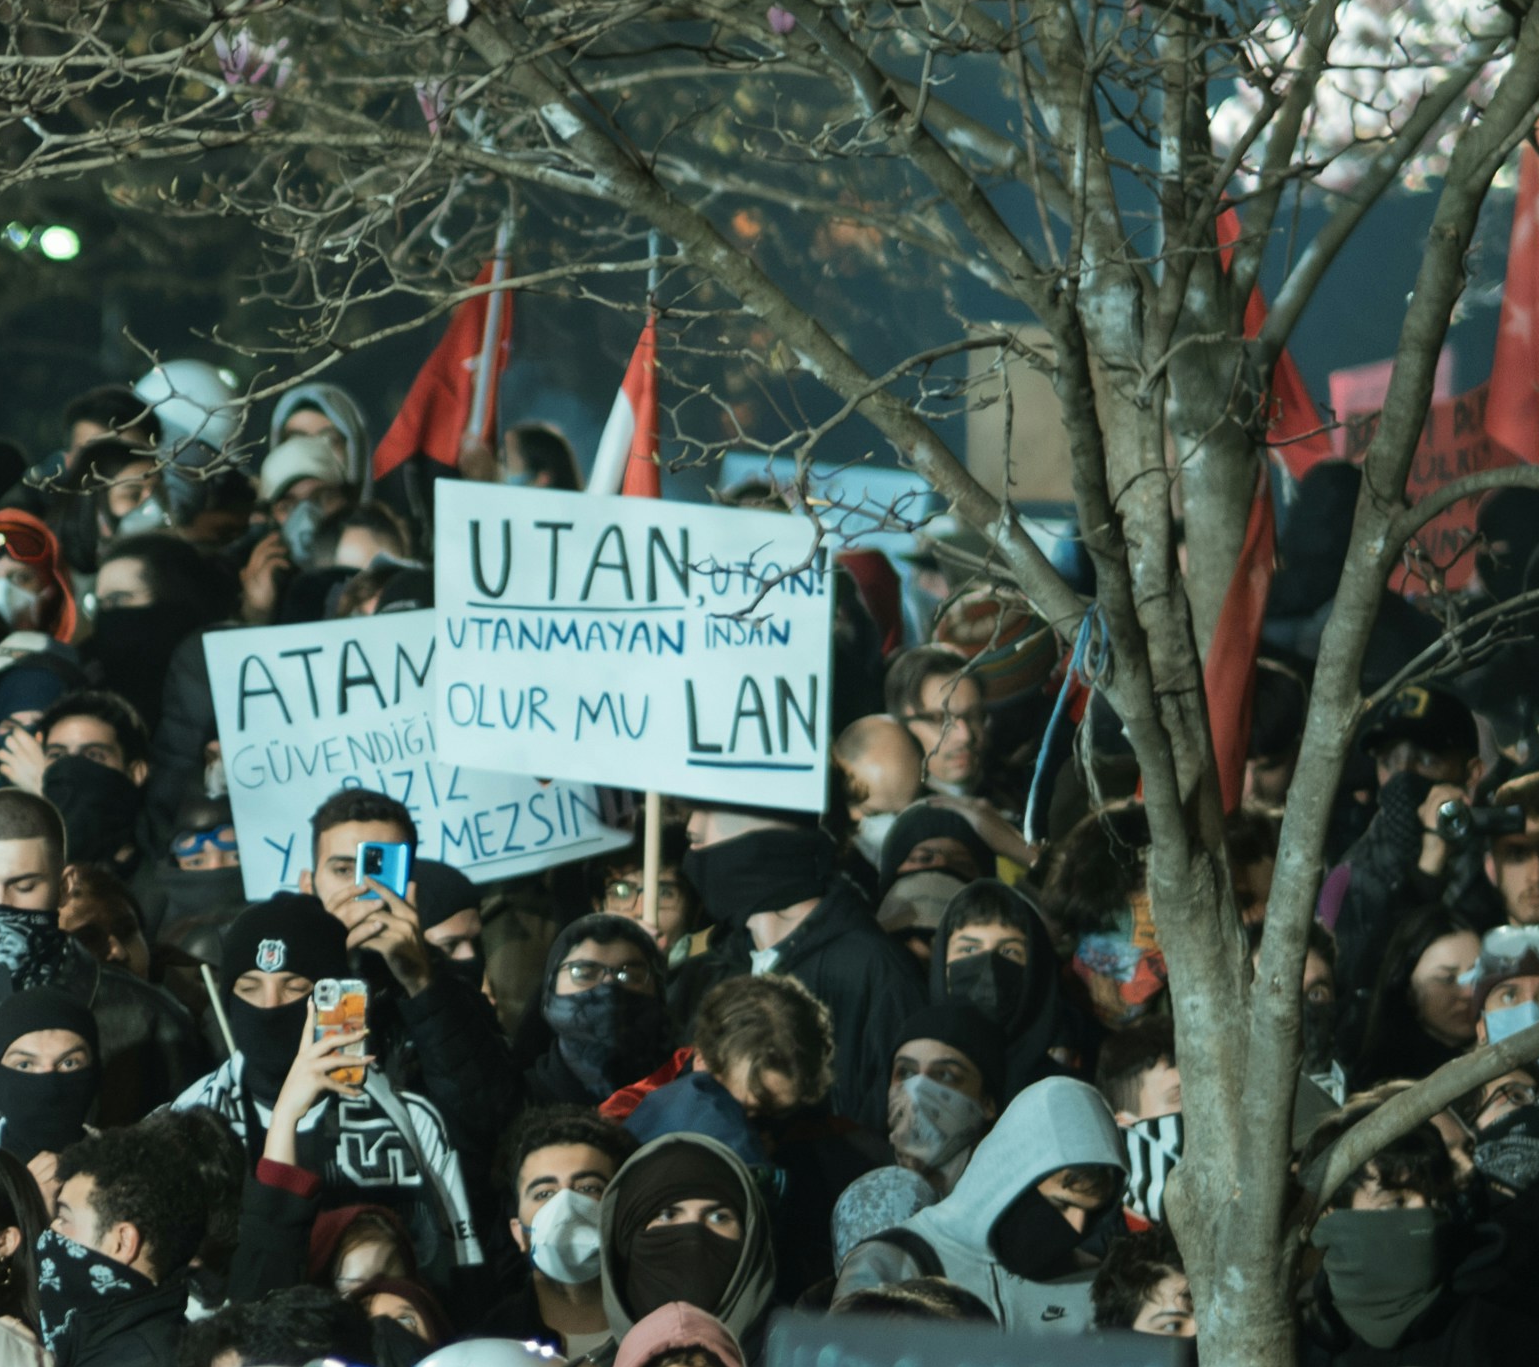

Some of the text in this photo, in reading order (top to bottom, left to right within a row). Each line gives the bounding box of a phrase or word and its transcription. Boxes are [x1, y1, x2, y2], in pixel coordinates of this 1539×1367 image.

[447, 616, 686, 656] UTANMAYAN
[447, 673, 819, 756] OLUR MU LAN
